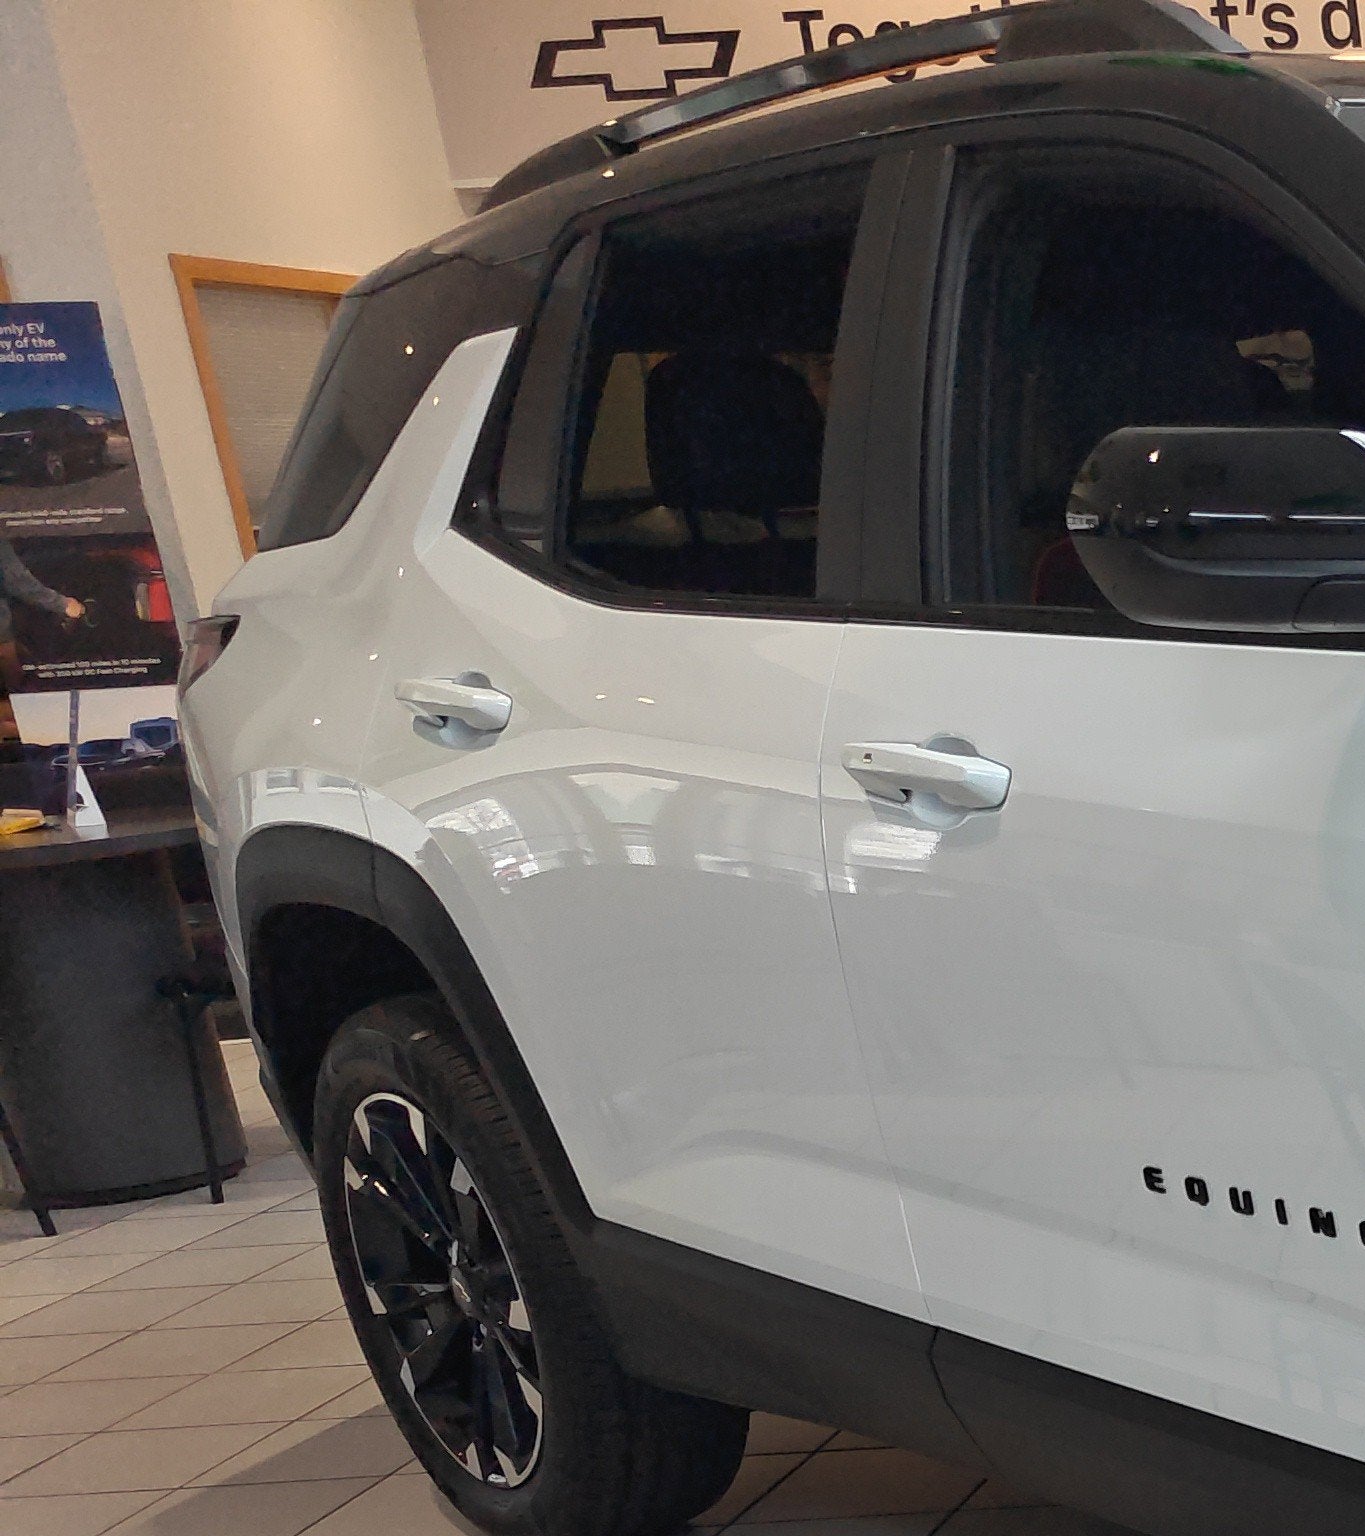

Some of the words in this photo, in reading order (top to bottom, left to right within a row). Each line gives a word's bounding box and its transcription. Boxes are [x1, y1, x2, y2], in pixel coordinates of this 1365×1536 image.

[26, 322, 45, 334] EV
[14, 336, 29, 349] of
[31, 337, 56, 348] the
[27, 352, 67, 363] name
